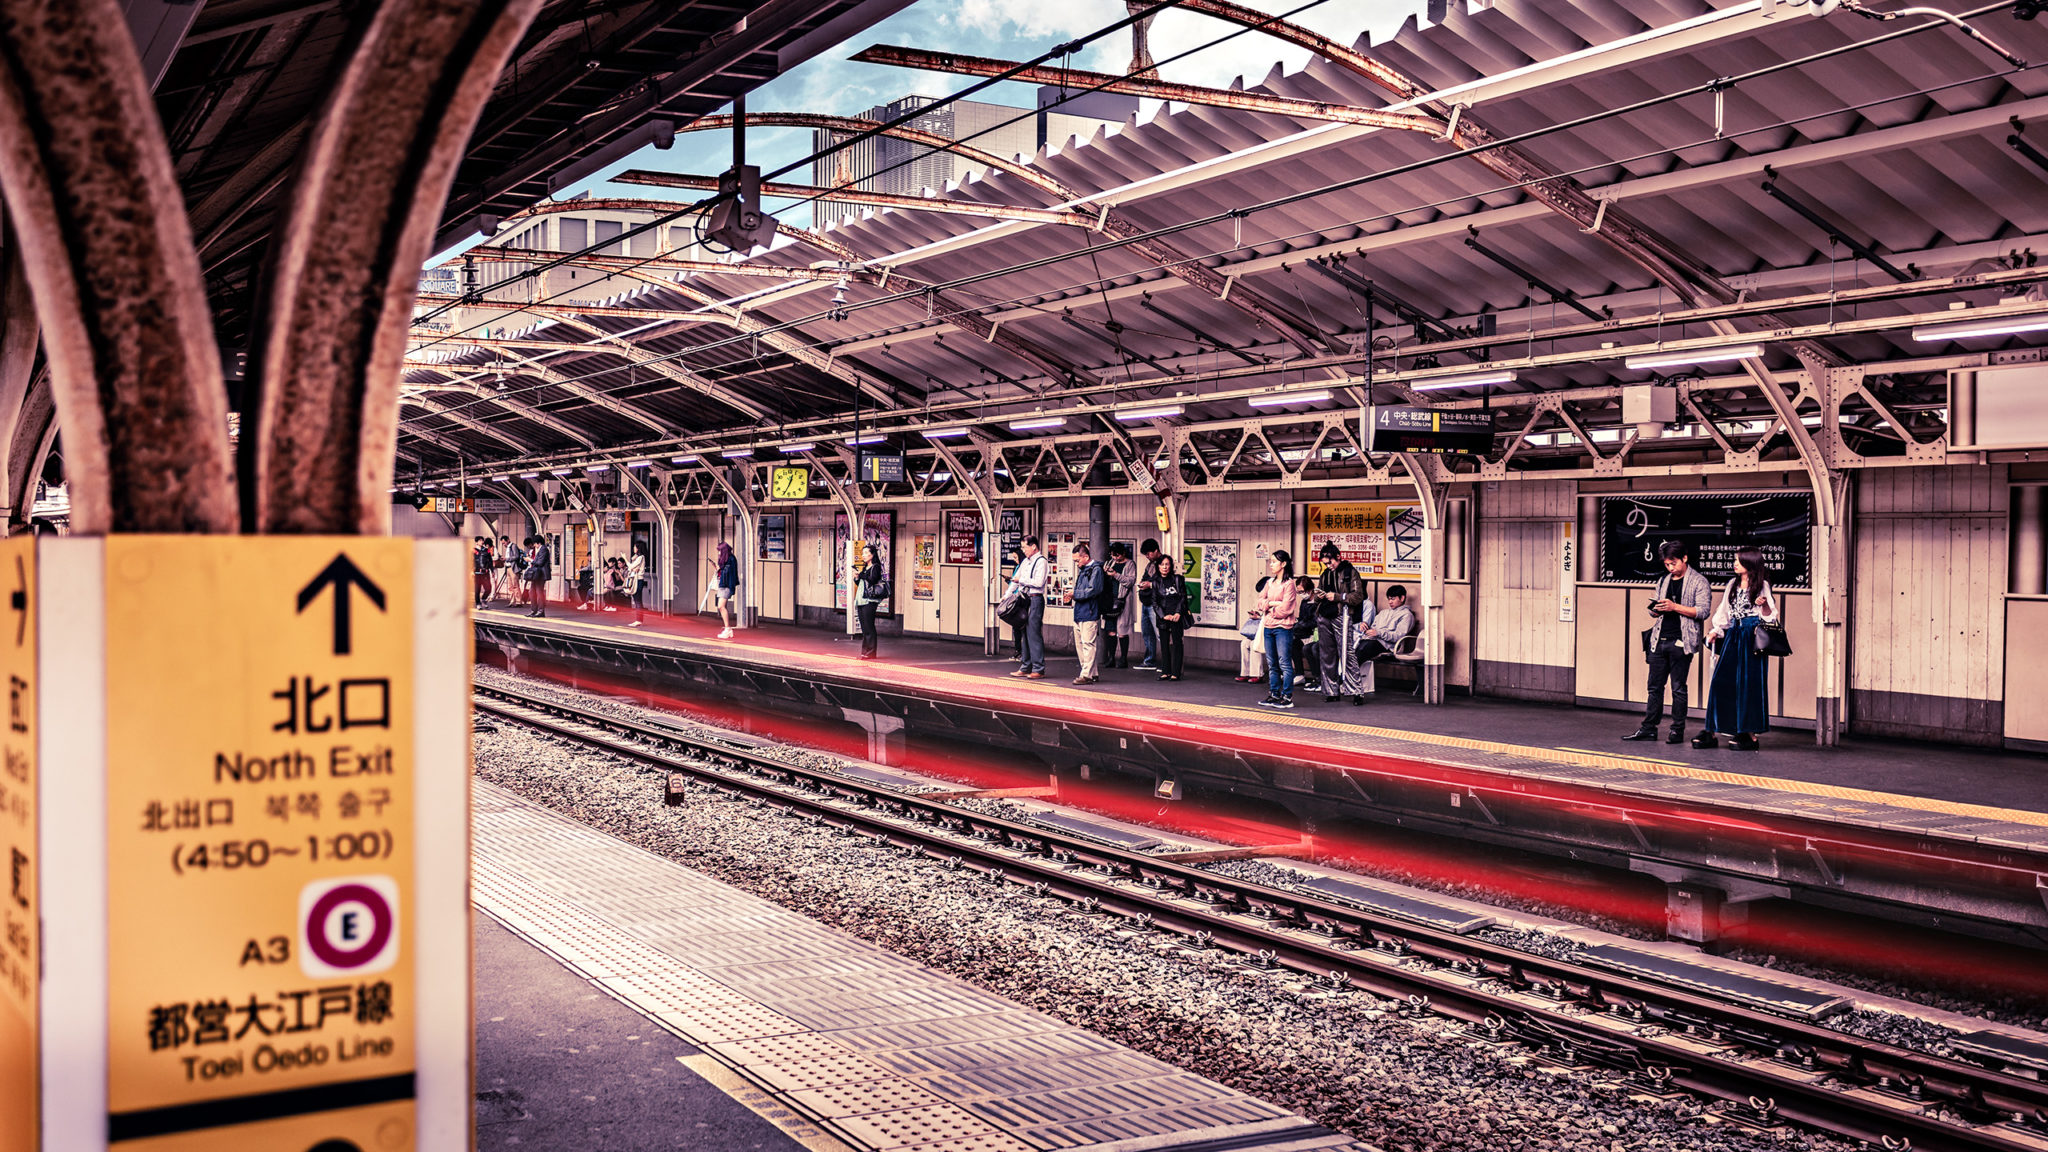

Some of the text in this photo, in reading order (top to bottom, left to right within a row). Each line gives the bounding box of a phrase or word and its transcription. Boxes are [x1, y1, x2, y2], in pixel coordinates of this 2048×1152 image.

[1380, 410, 1390, 426] 4
[1394, 412, 1431, 421] 中央・総武線
[863, 457, 872, 470] 4
[1324, 513, 1385, 529] 東京税理士会
[271, 676, 392, 735] 北口
[215, 746, 395, 784] North Exit
[671, 778, 682, 788] 6
[141, 799, 234, 831] 北出口
[341, 911, 359, 941] E
[239, 938, 291, 967] A3
[147, 981, 395, 1052] 都営大江戸線
[182, 1052, 245, 1083] Toei
[337, 1032, 395, 1063] Line
